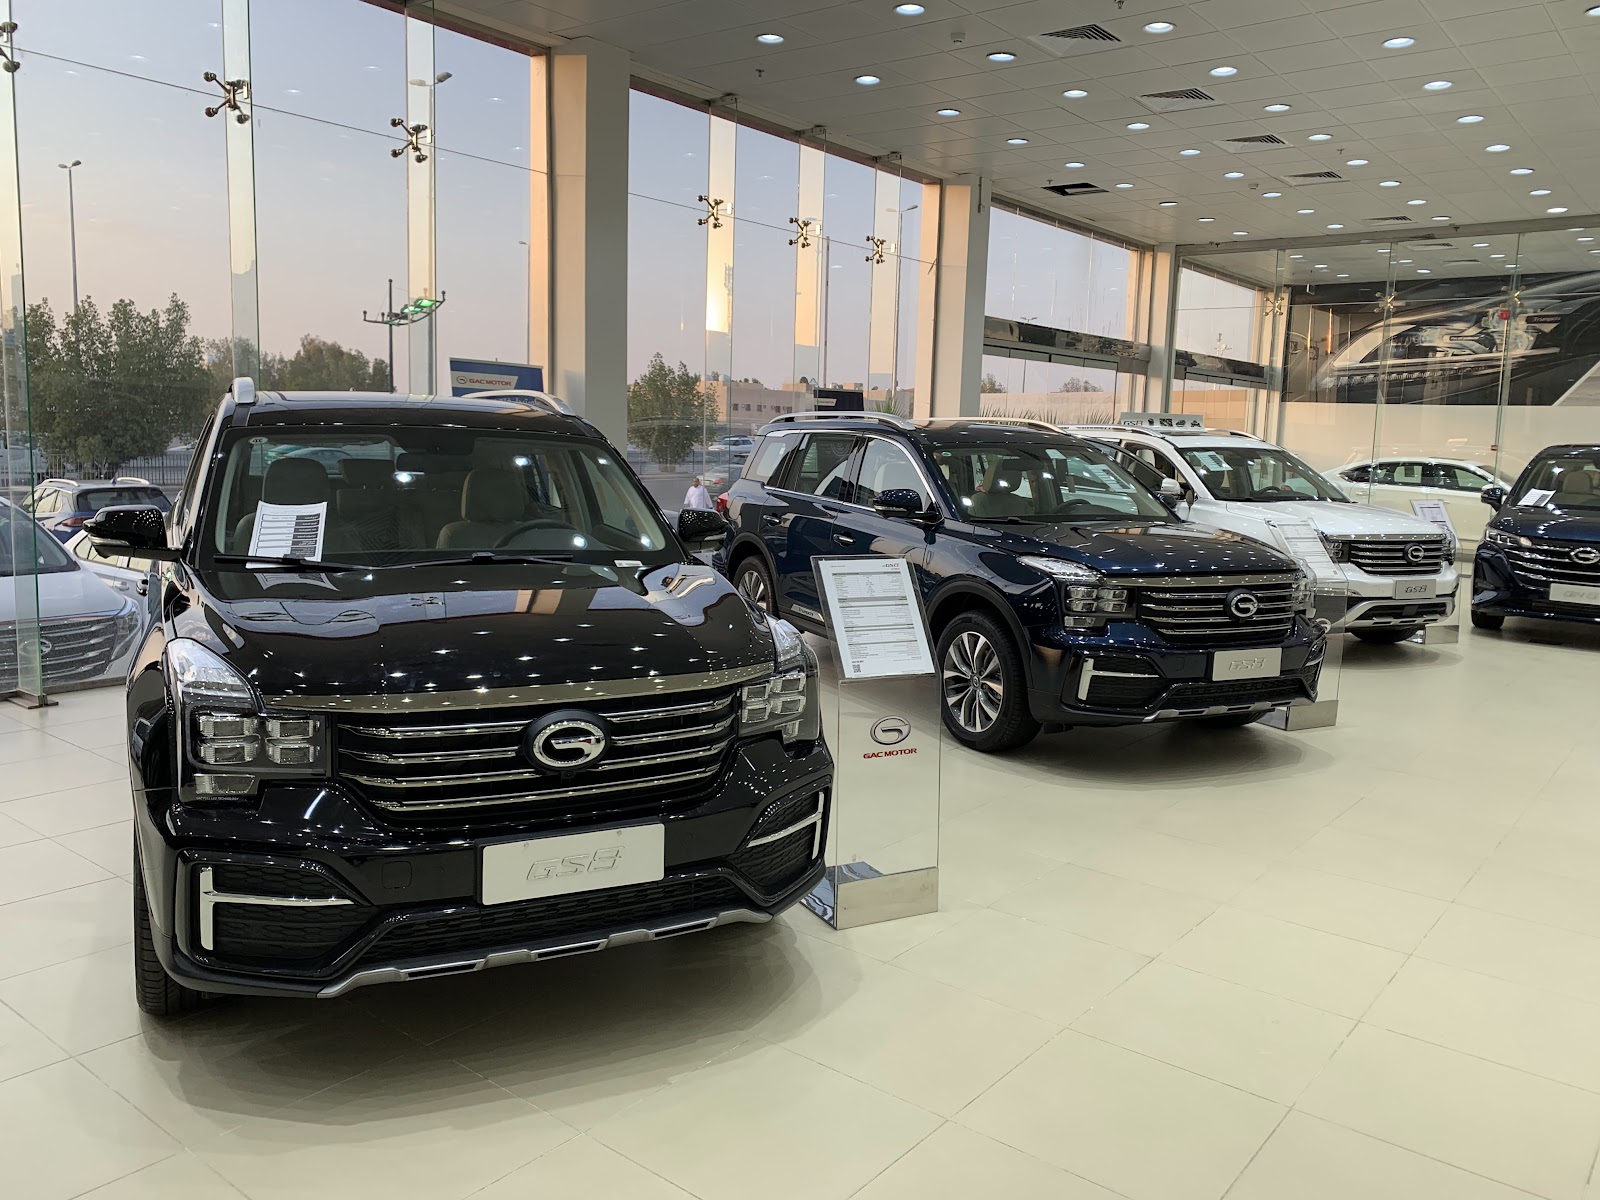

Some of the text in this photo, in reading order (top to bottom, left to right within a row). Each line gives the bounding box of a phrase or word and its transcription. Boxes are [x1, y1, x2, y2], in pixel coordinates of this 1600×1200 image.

[486, 379, 512, 387] MOTOR
[1405, 585, 1427, 593] GS8
[863, 748, 917, 759] GAC MOTOR
[526, 845, 626, 881] GS8
